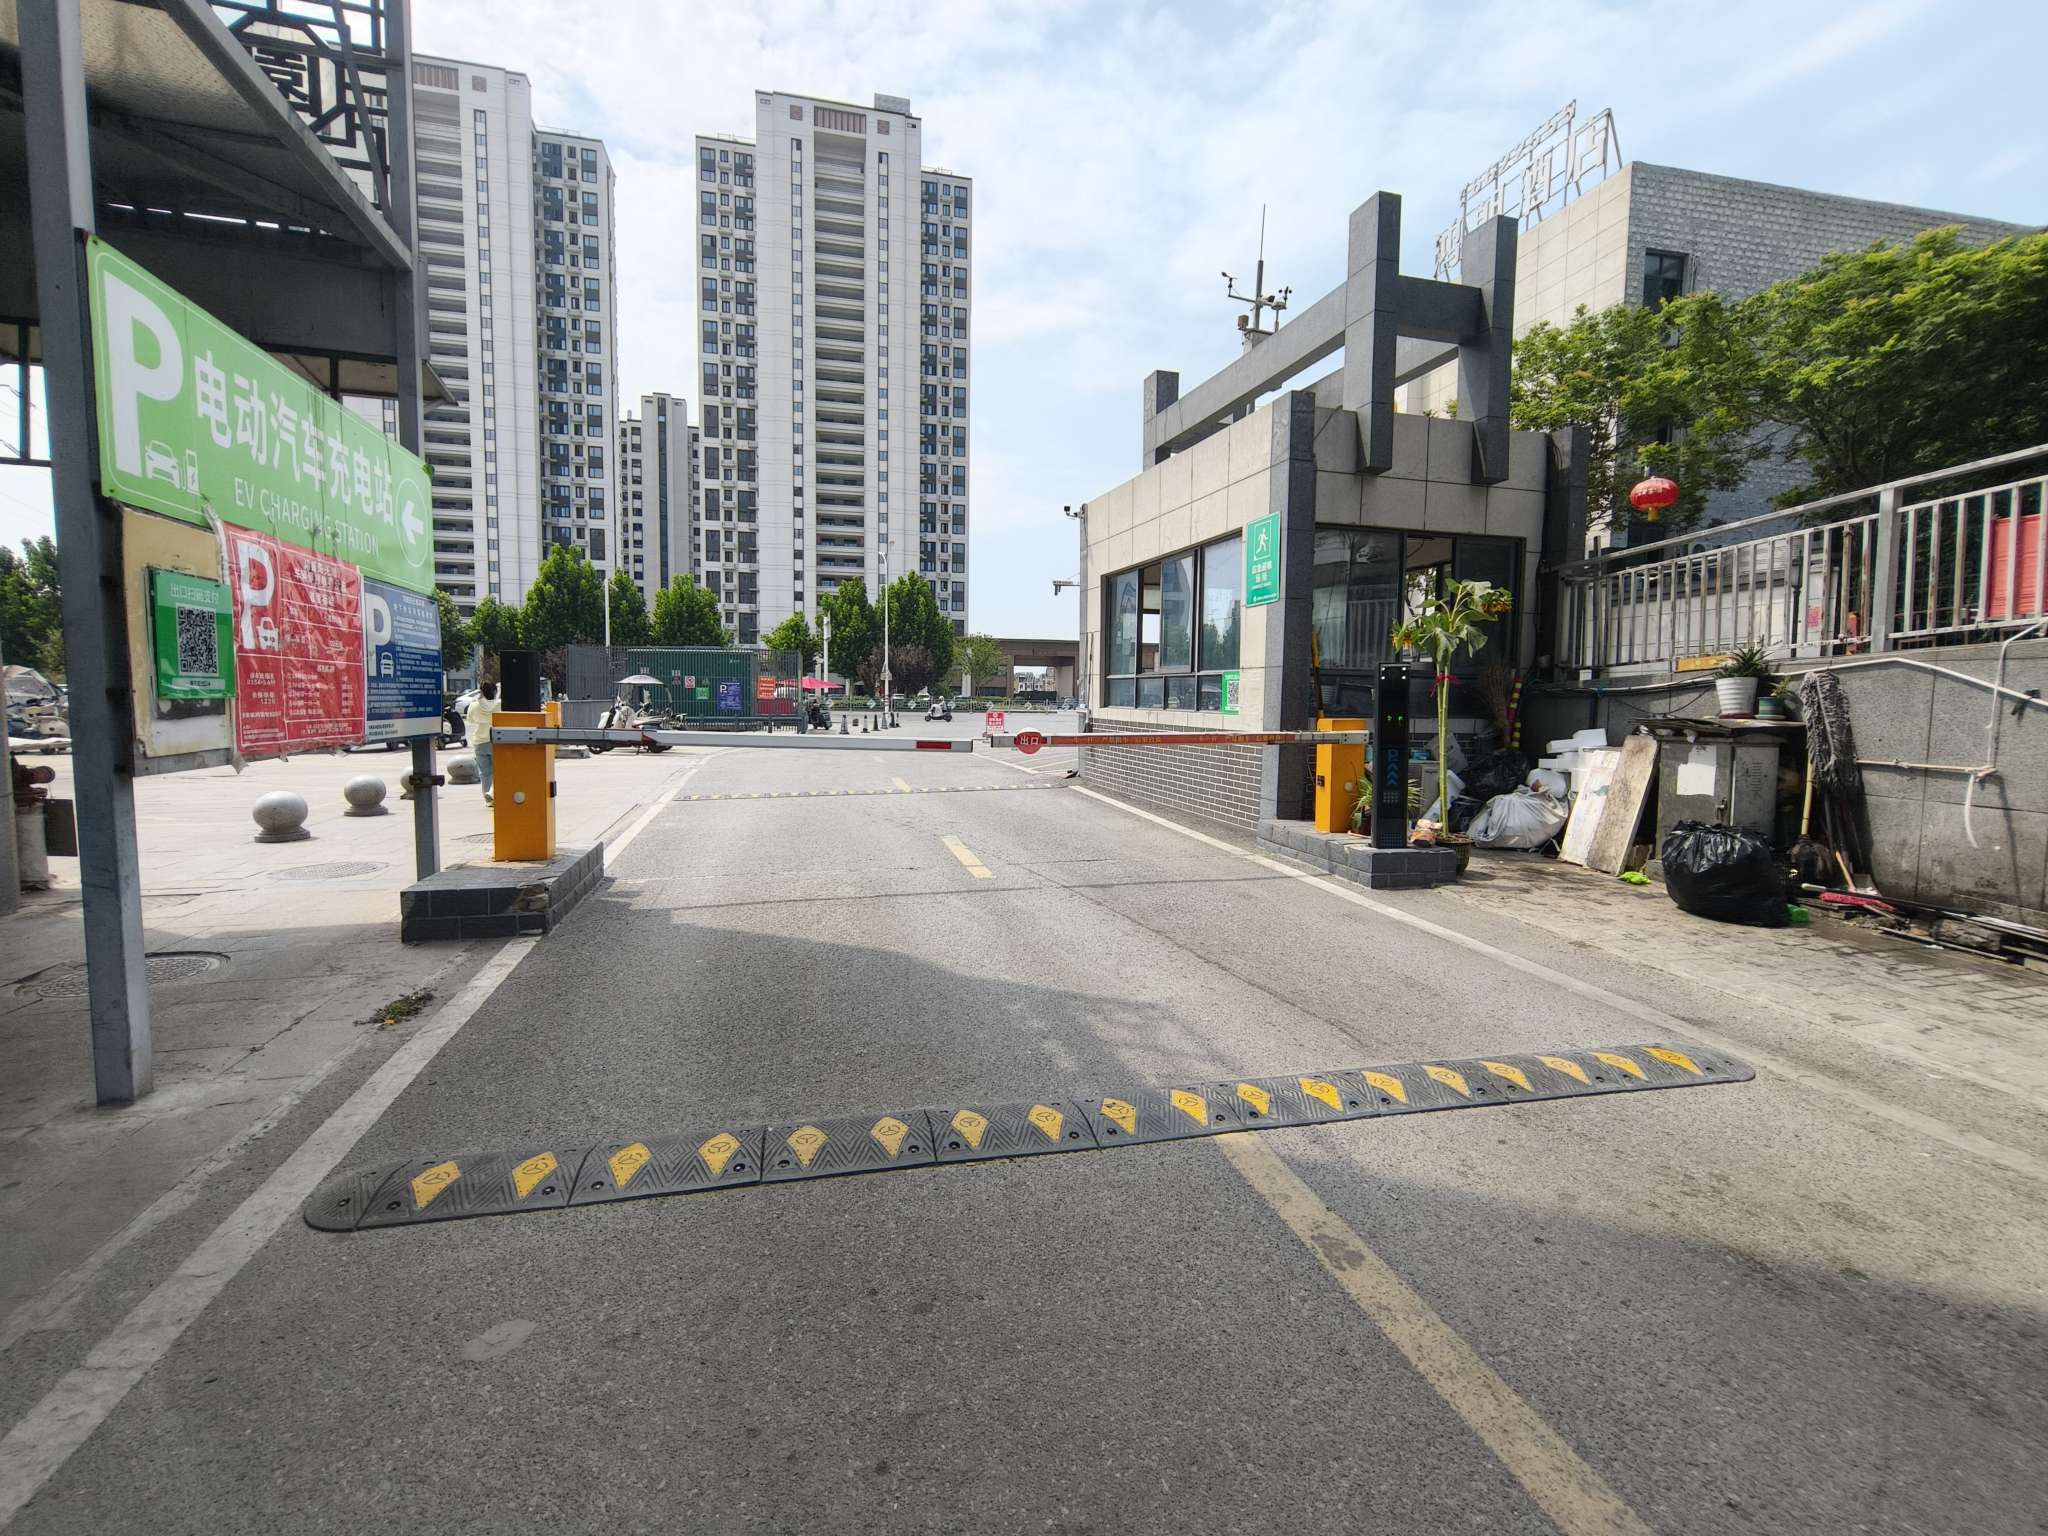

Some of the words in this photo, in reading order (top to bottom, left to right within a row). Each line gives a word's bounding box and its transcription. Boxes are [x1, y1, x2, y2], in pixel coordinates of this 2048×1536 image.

[104, 270, 183, 477] P
[194, 350, 396, 526] 电动汽车充电站
[234, 477, 256, 508] EV
[260, 489, 334, 539] CHARGING
[335, 516, 380, 555] STATION
[237, 540, 275, 650] P
[366, 593, 392, 676] P
[1020, 735, 1039, 745] 出口
